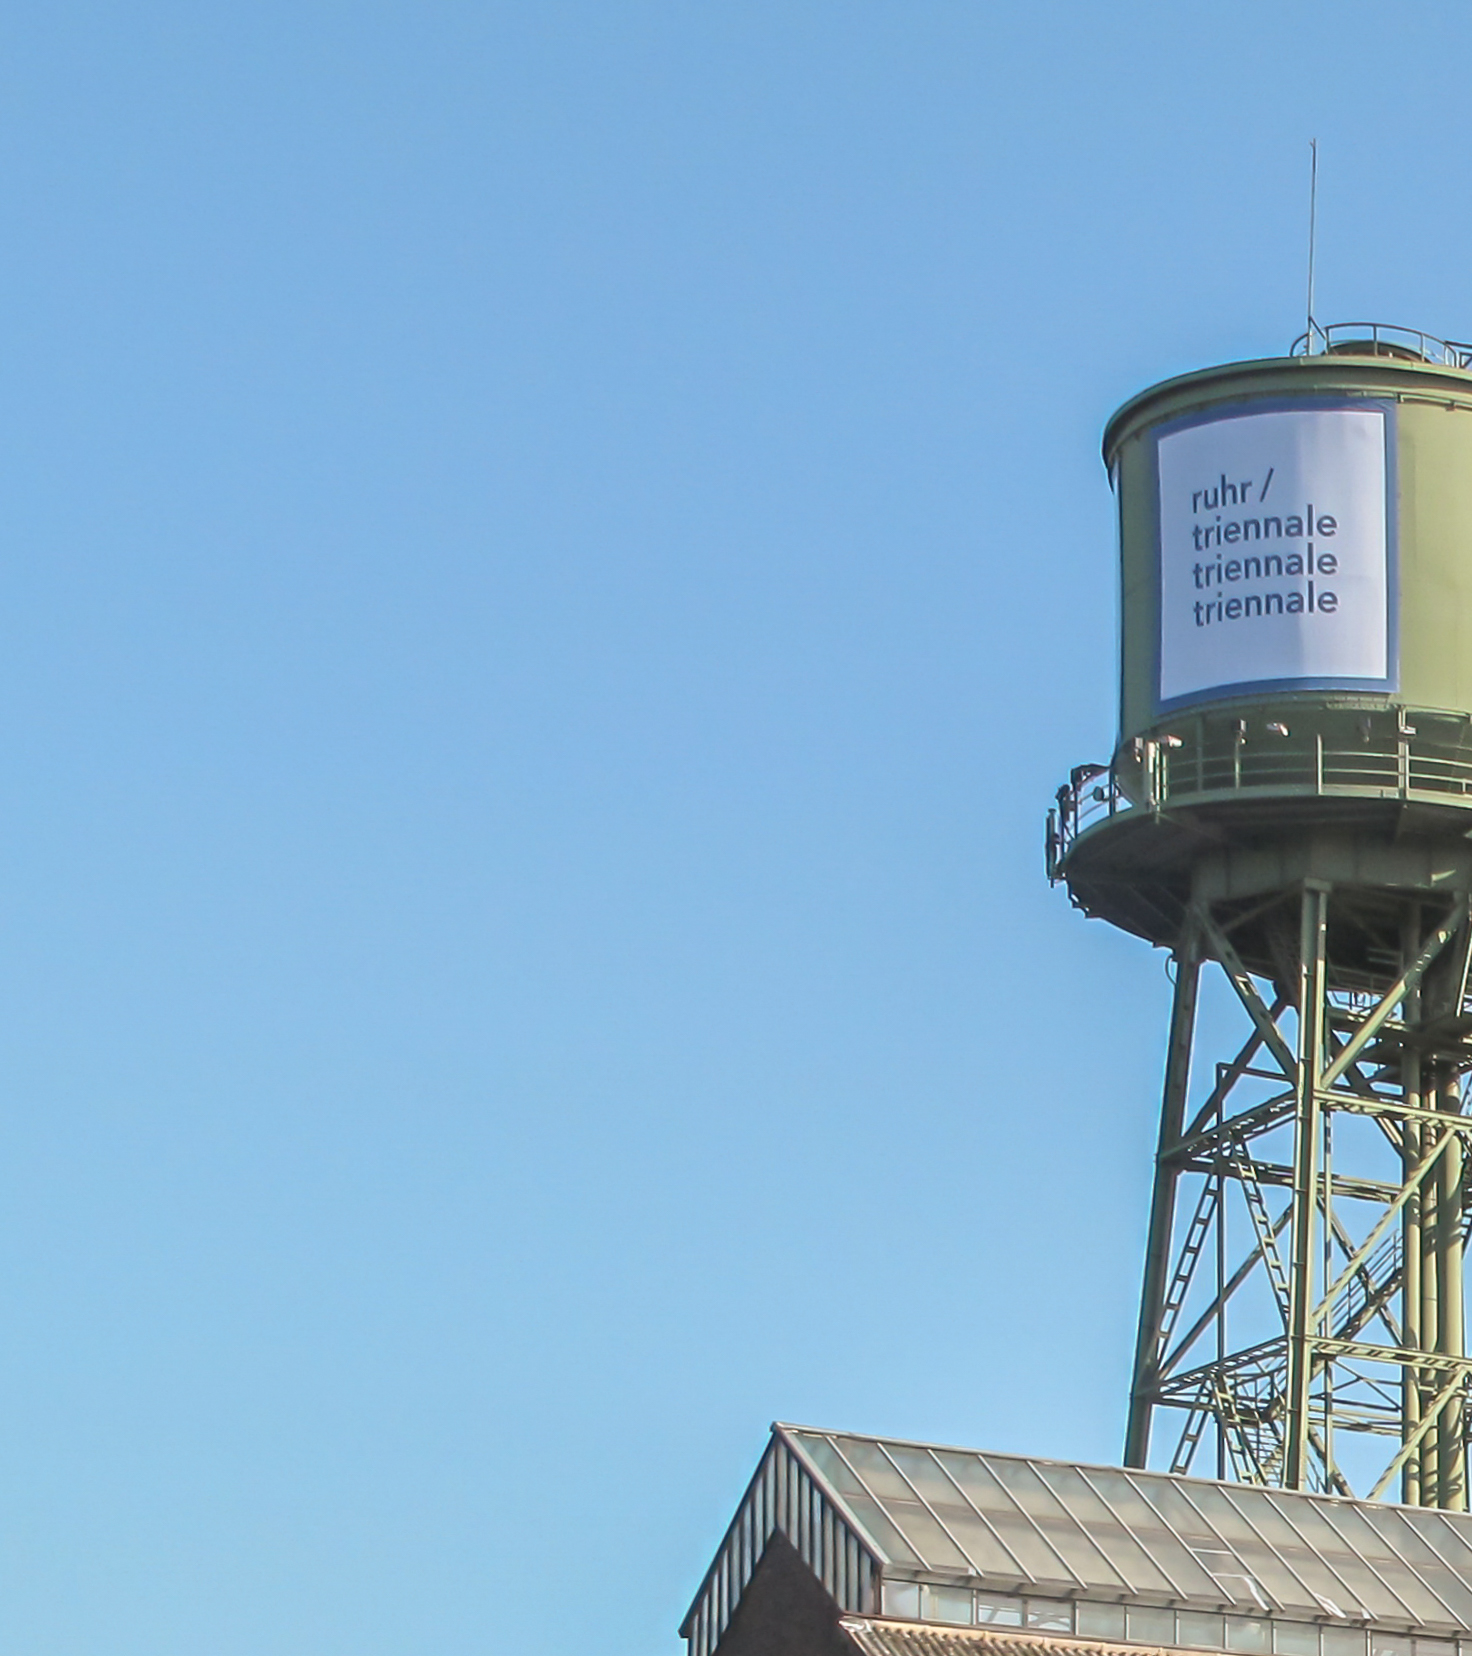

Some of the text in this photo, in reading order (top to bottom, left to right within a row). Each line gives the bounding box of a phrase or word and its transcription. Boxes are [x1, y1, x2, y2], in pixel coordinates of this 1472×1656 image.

[1191, 474, 1252, 514] ruhr
[1192, 503, 1338, 551] triennale
[1192, 542, 1339, 590] triennale
[1193, 580, 1339, 627] triennale
